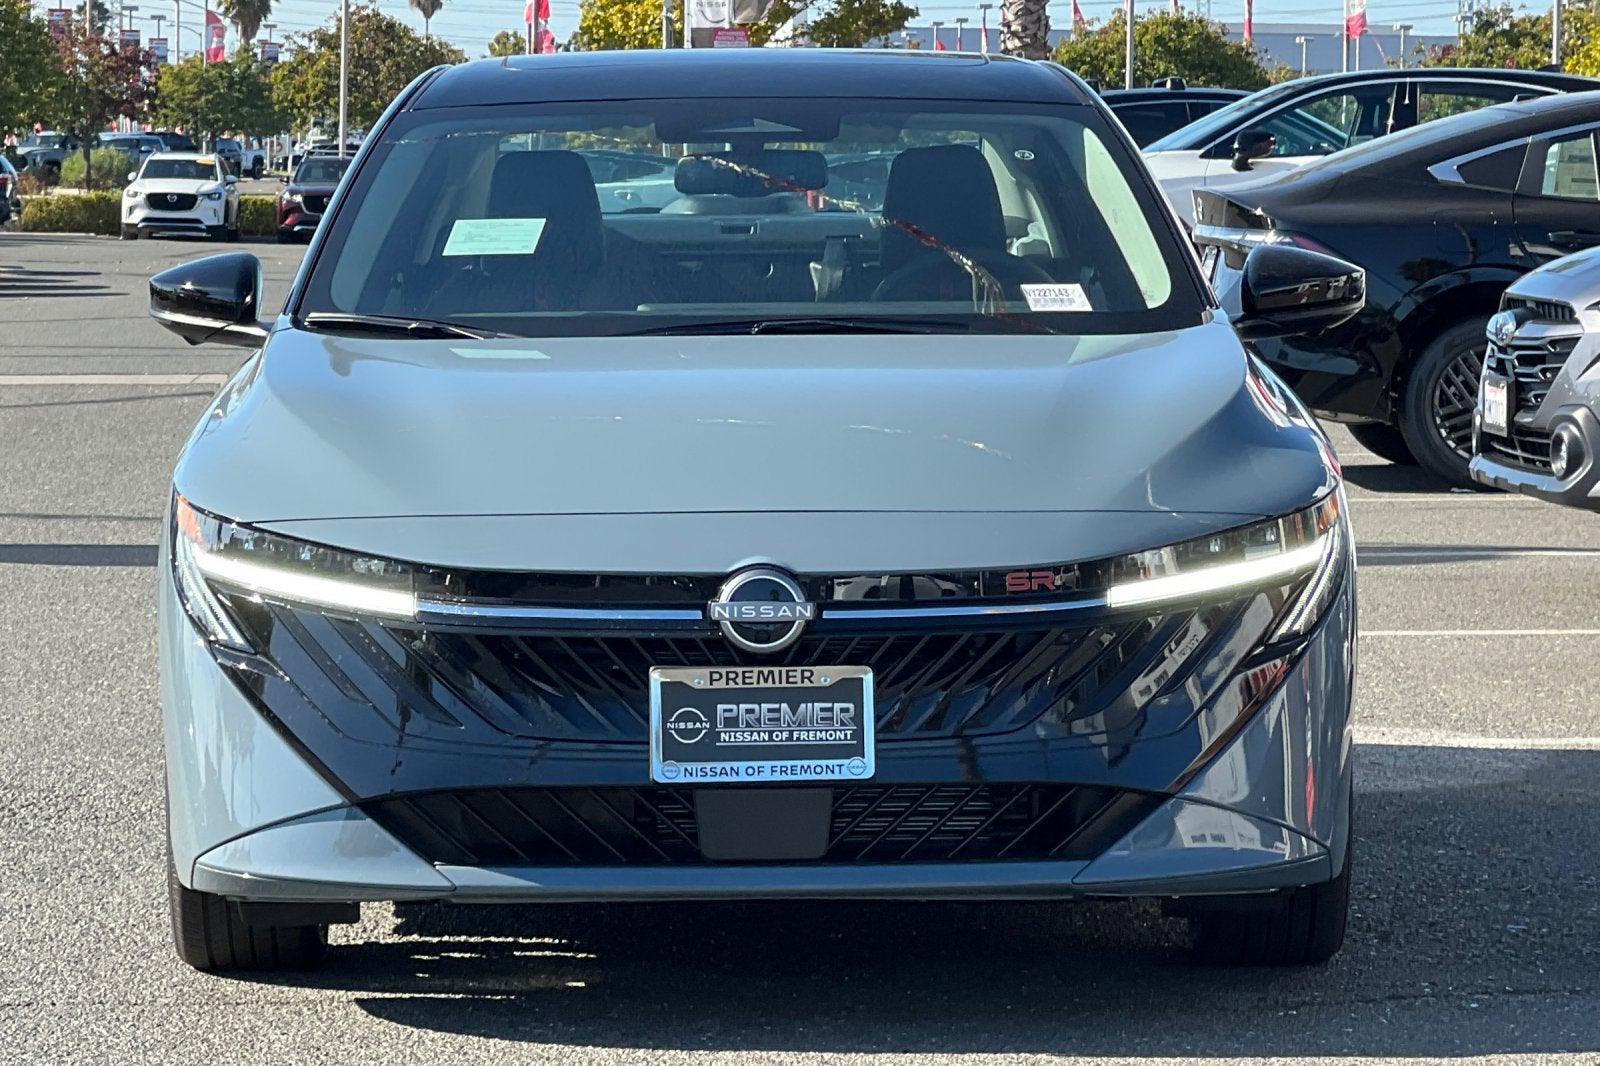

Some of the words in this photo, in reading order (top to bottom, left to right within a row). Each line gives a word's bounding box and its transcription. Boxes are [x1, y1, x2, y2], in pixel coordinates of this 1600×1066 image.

[1006, 571, 1056, 592] SR
[714, 605, 811, 619] NISSAN
[709, 669, 815, 686] PREMIER
[716, 702, 856, 728] PREMIER
[666, 721, 710, 729] NISSAN
[720, 731, 769, 742] NISSAN
[772, 731, 789, 742] OF
[793, 730, 852, 741] FREMONT
[683, 766, 740, 778] NISSAN
[745, 765, 765, 777] OF
[770, 763, 845, 776] FREMONT
